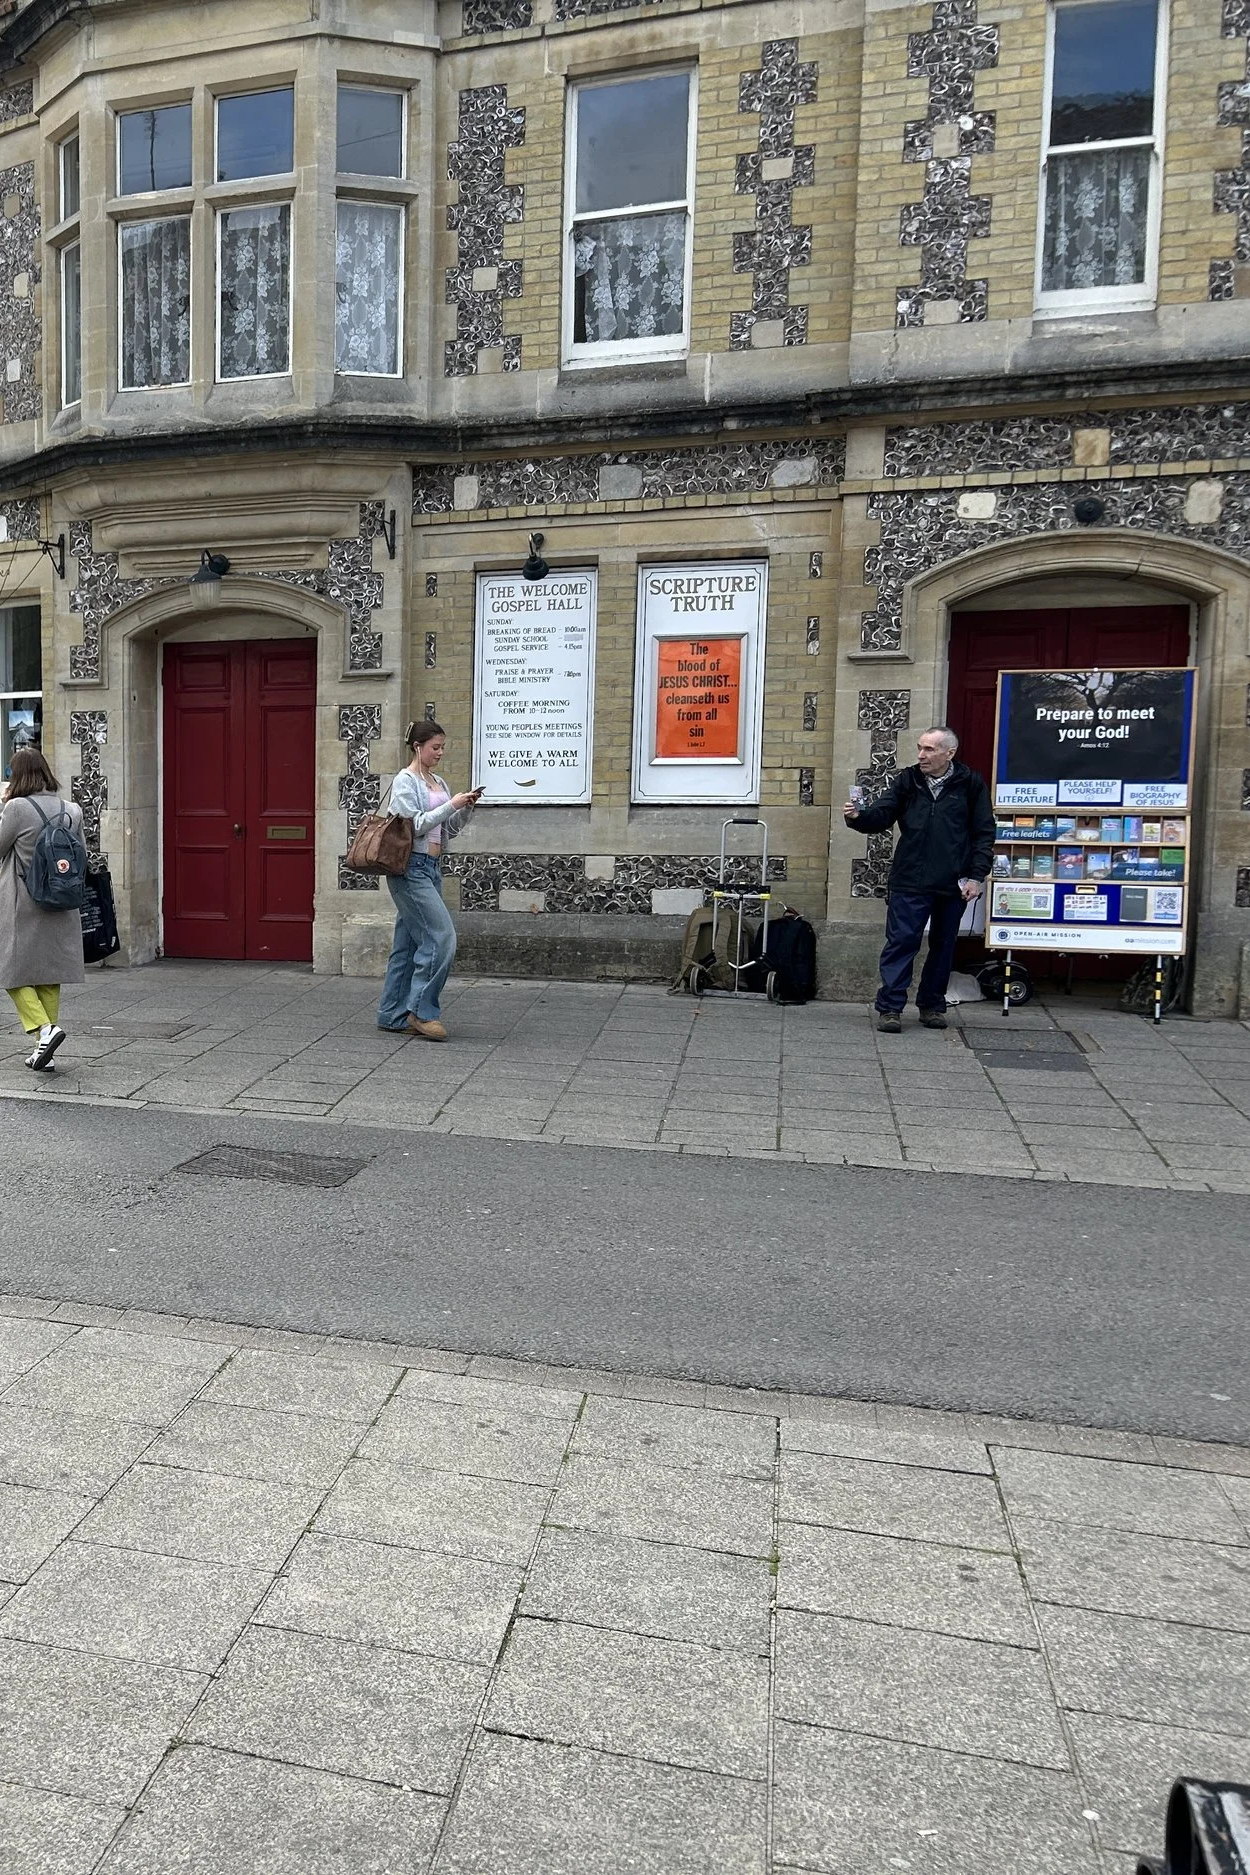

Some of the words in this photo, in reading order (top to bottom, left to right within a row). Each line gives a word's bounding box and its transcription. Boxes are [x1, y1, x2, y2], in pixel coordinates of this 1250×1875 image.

[488, 586, 515, 598] THE
[520, 583, 588, 597] WELCOME
[649, 576, 757, 595] SCRIPTURE
[492, 600, 542, 613] GOSPEL
[547, 598, 582, 610] HALL
[670, 594, 735, 612] TRUTH
[487, 628, 521, 636] BREAKING
[534, 626, 556, 634] BREAD
[494, 636, 521, 644] SUNDAY
[690, 642, 708, 655] The
[678, 659, 706, 672] blood
[710, 658, 720, 671] of
[495, 668, 521, 676] PRAISE
[658, 676, 689, 688] JESUS
[692, 674, 738, 688] CHRIST...
[498, 700, 530, 708] COFFEE
[666, 692, 715, 704] cleanseth
[718, 694, 730, 704] us
[676, 708, 702, 720] from
[706, 708, 718, 720] all
[1036, 708, 1094, 723] Prepare
[1098, 708, 1114, 720] to
[1116, 707, 1155, 720] meet
[689, 724, 704, 738] sin
[1058, 728, 1091, 742] your
[1095, 725, 1130, 740] God!
[508, 750, 532, 758] GIVE
[536, 750, 542, 758] A
[546, 750, 578, 758] WARM
[488, 760, 538, 768] WELCOME
[559, 759, 579, 767] ALL
[1002, 830, 1019, 838] Free
[1020, 830, 1050, 839] leaflets
[1125, 868, 1152, 876] Please
[1154, 868, 1176, 876] take!
